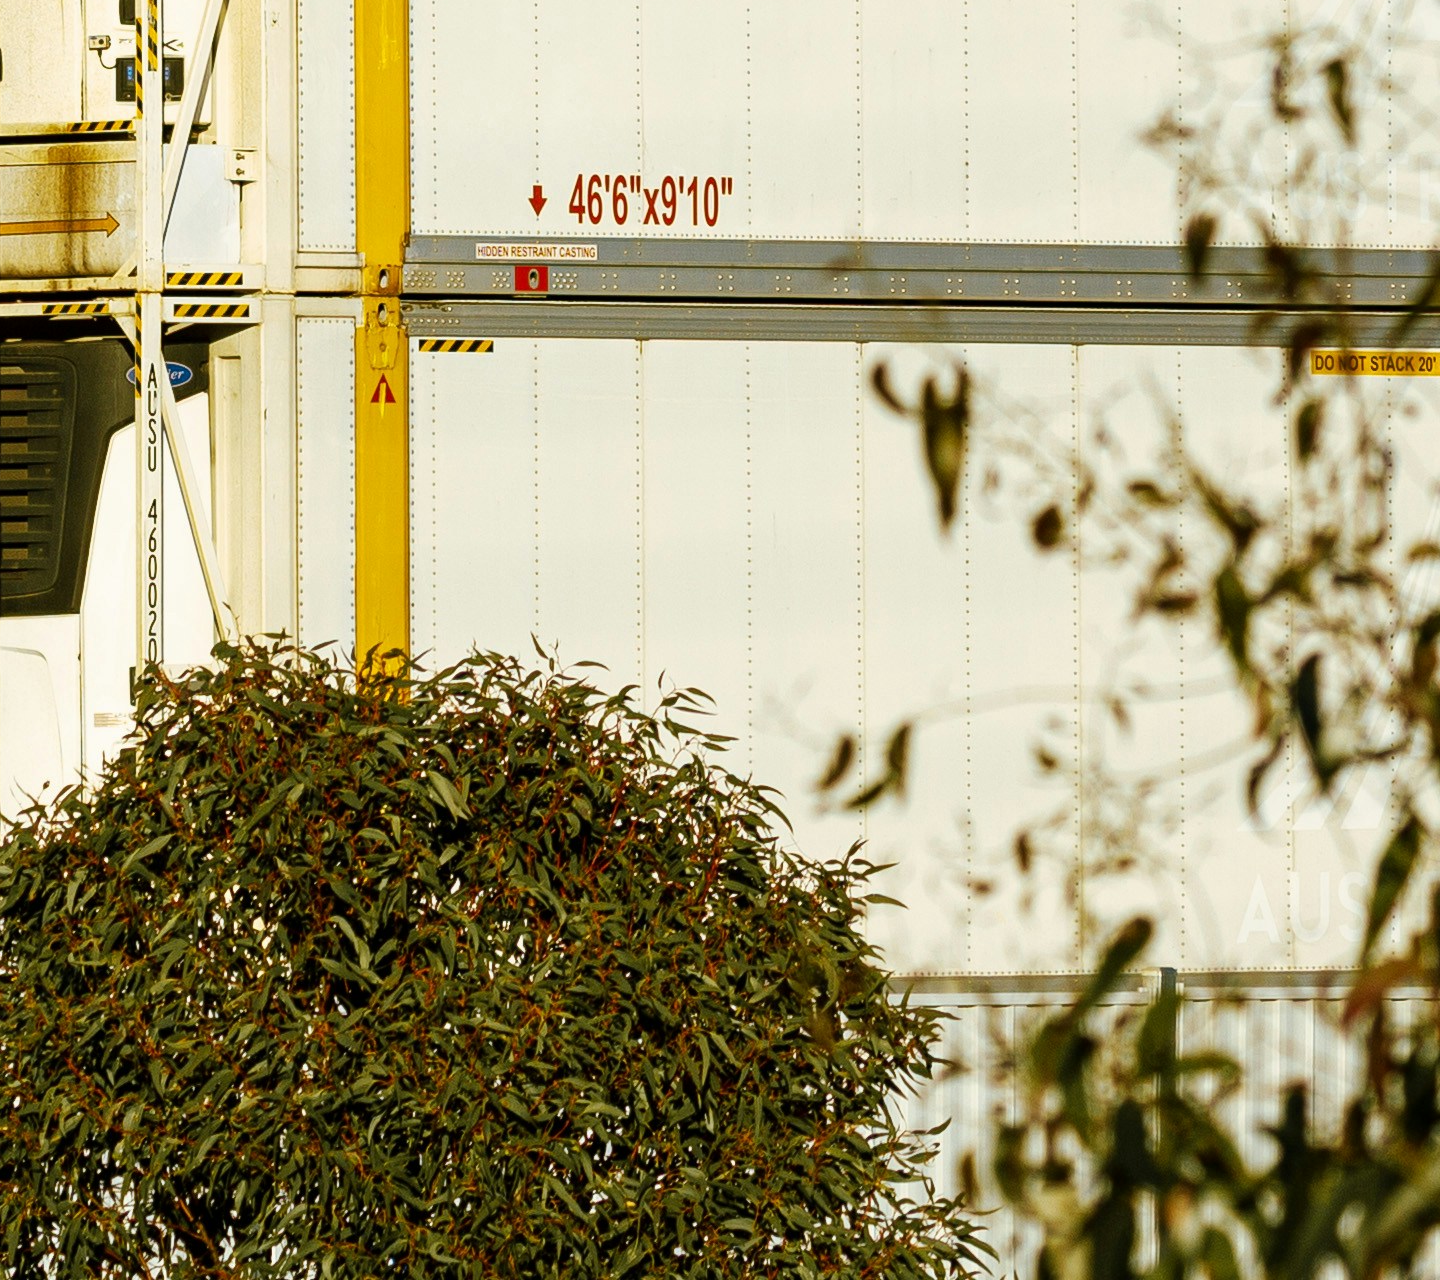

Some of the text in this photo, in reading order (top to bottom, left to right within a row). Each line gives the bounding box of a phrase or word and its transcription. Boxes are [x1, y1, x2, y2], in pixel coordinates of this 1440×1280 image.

[477, 245, 596, 259] HIDDEN RESTRAINT CASTING
[1315, 355, 1334, 371] DO
[1338, 355, 1366, 372] NOT
[1370, 355, 1415, 372] STACK
[1418, 356, 1437, 373] 20'
[146, 363, 158, 663] AUSU 460020
